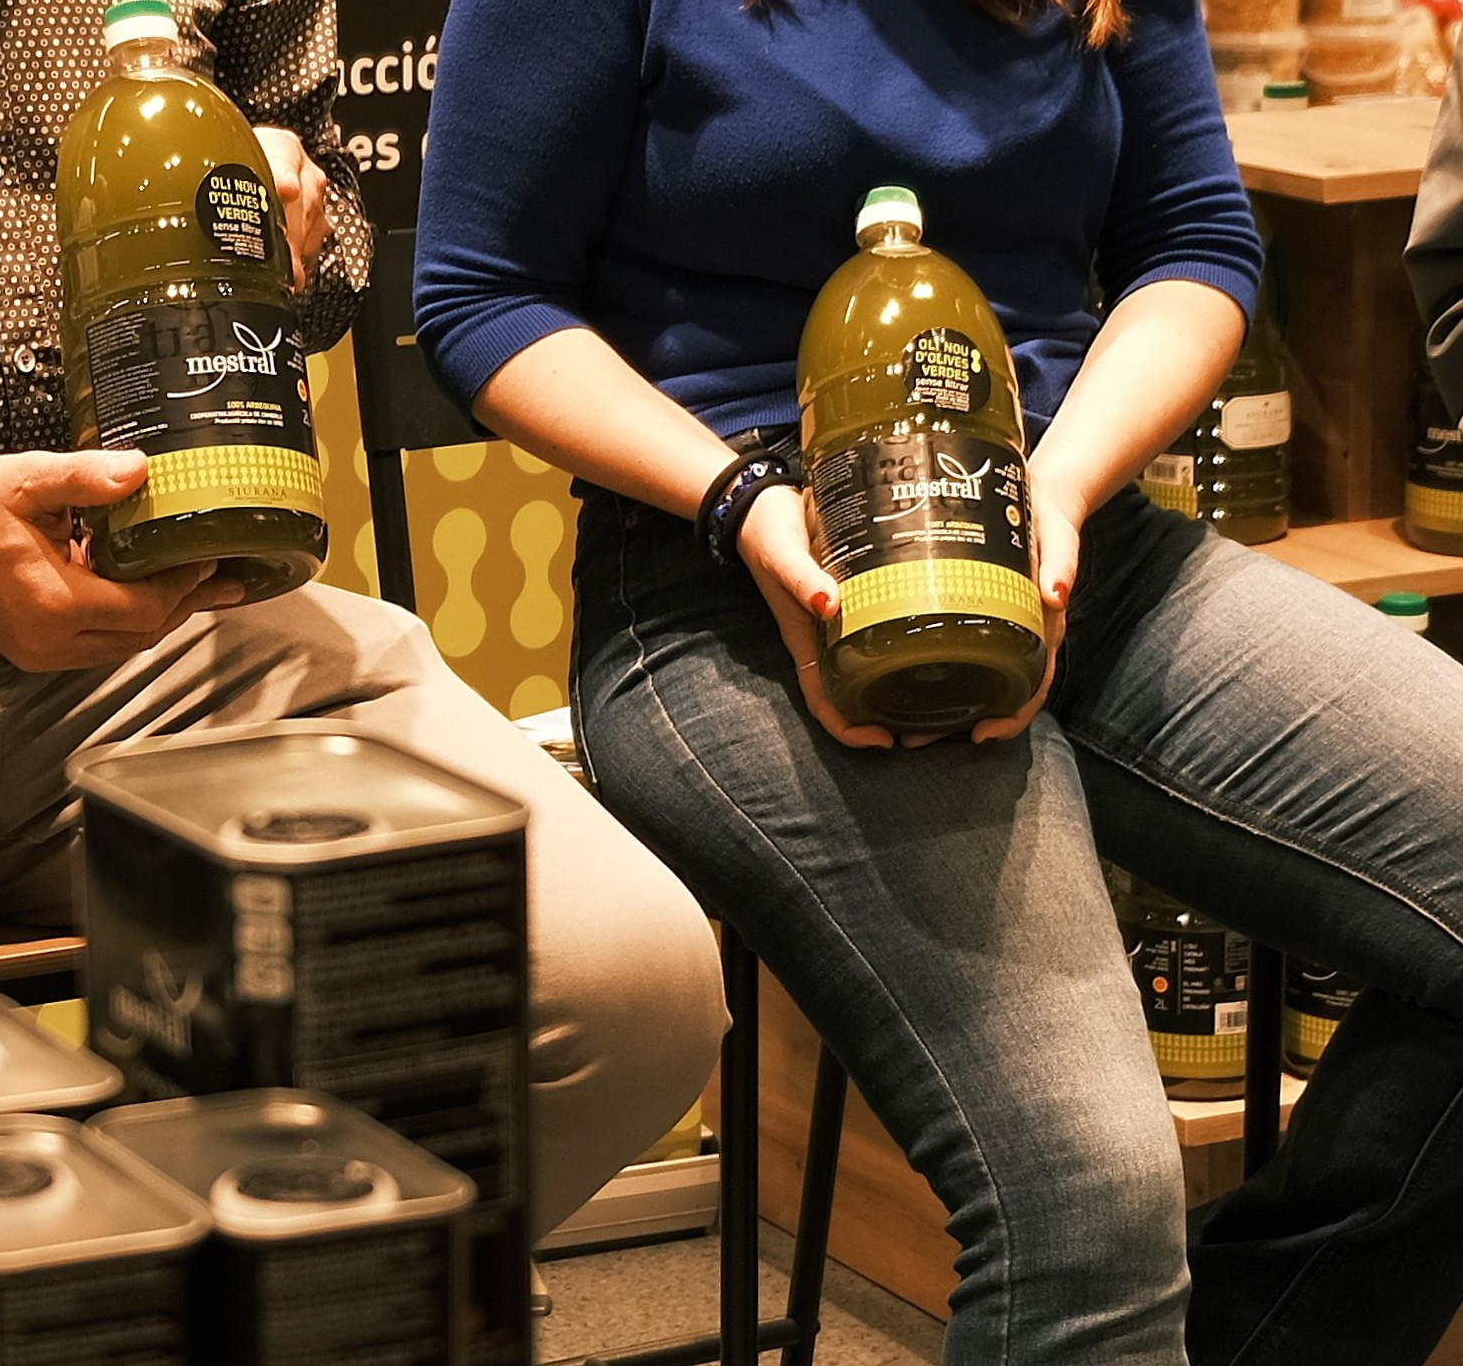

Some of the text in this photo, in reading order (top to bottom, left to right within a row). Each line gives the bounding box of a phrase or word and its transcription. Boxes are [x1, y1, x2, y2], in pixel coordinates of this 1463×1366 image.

[336, 34, 438, 97] cció
[210, 176, 257, 194] OLI NOU
[216, 206, 261, 224] VERDES
[212, 222, 240, 231] sense
[918, 338, 969, 357] OLI NOU
[185, 350, 278, 376] mestral
[921, 364, 970, 383] VERDES
[227, 487, 288, 499] SIURANA
[891, 477, 982, 502] mestral
